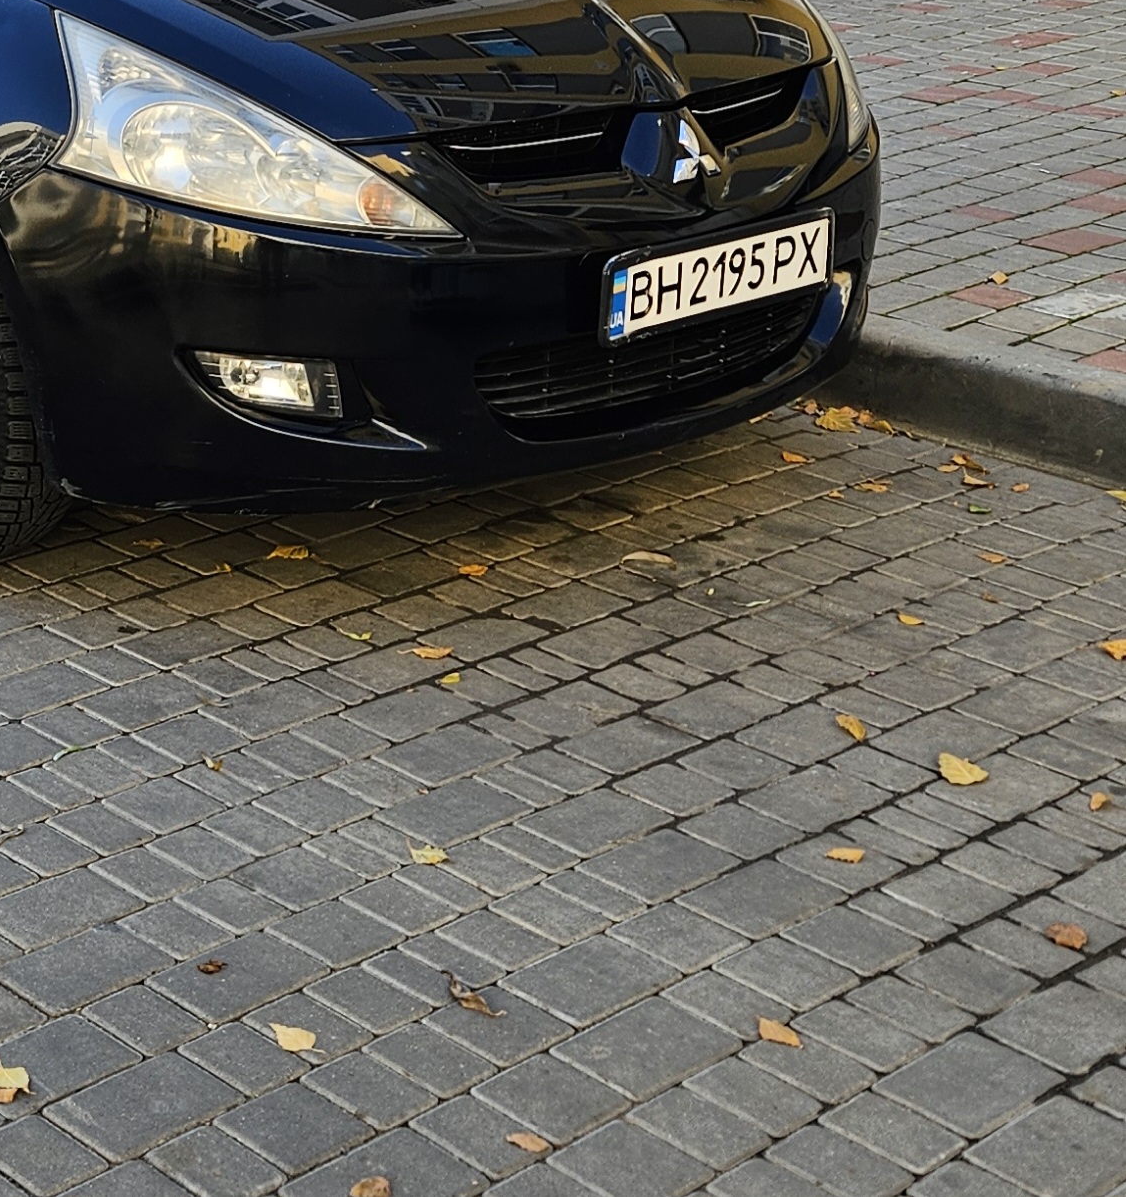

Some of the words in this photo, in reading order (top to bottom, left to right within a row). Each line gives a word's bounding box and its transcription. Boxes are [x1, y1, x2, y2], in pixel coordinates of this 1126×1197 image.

[629, 261, 683, 322] BH
[689, 241, 766, 307] 2195
[609, 310, 624, 329] UA
